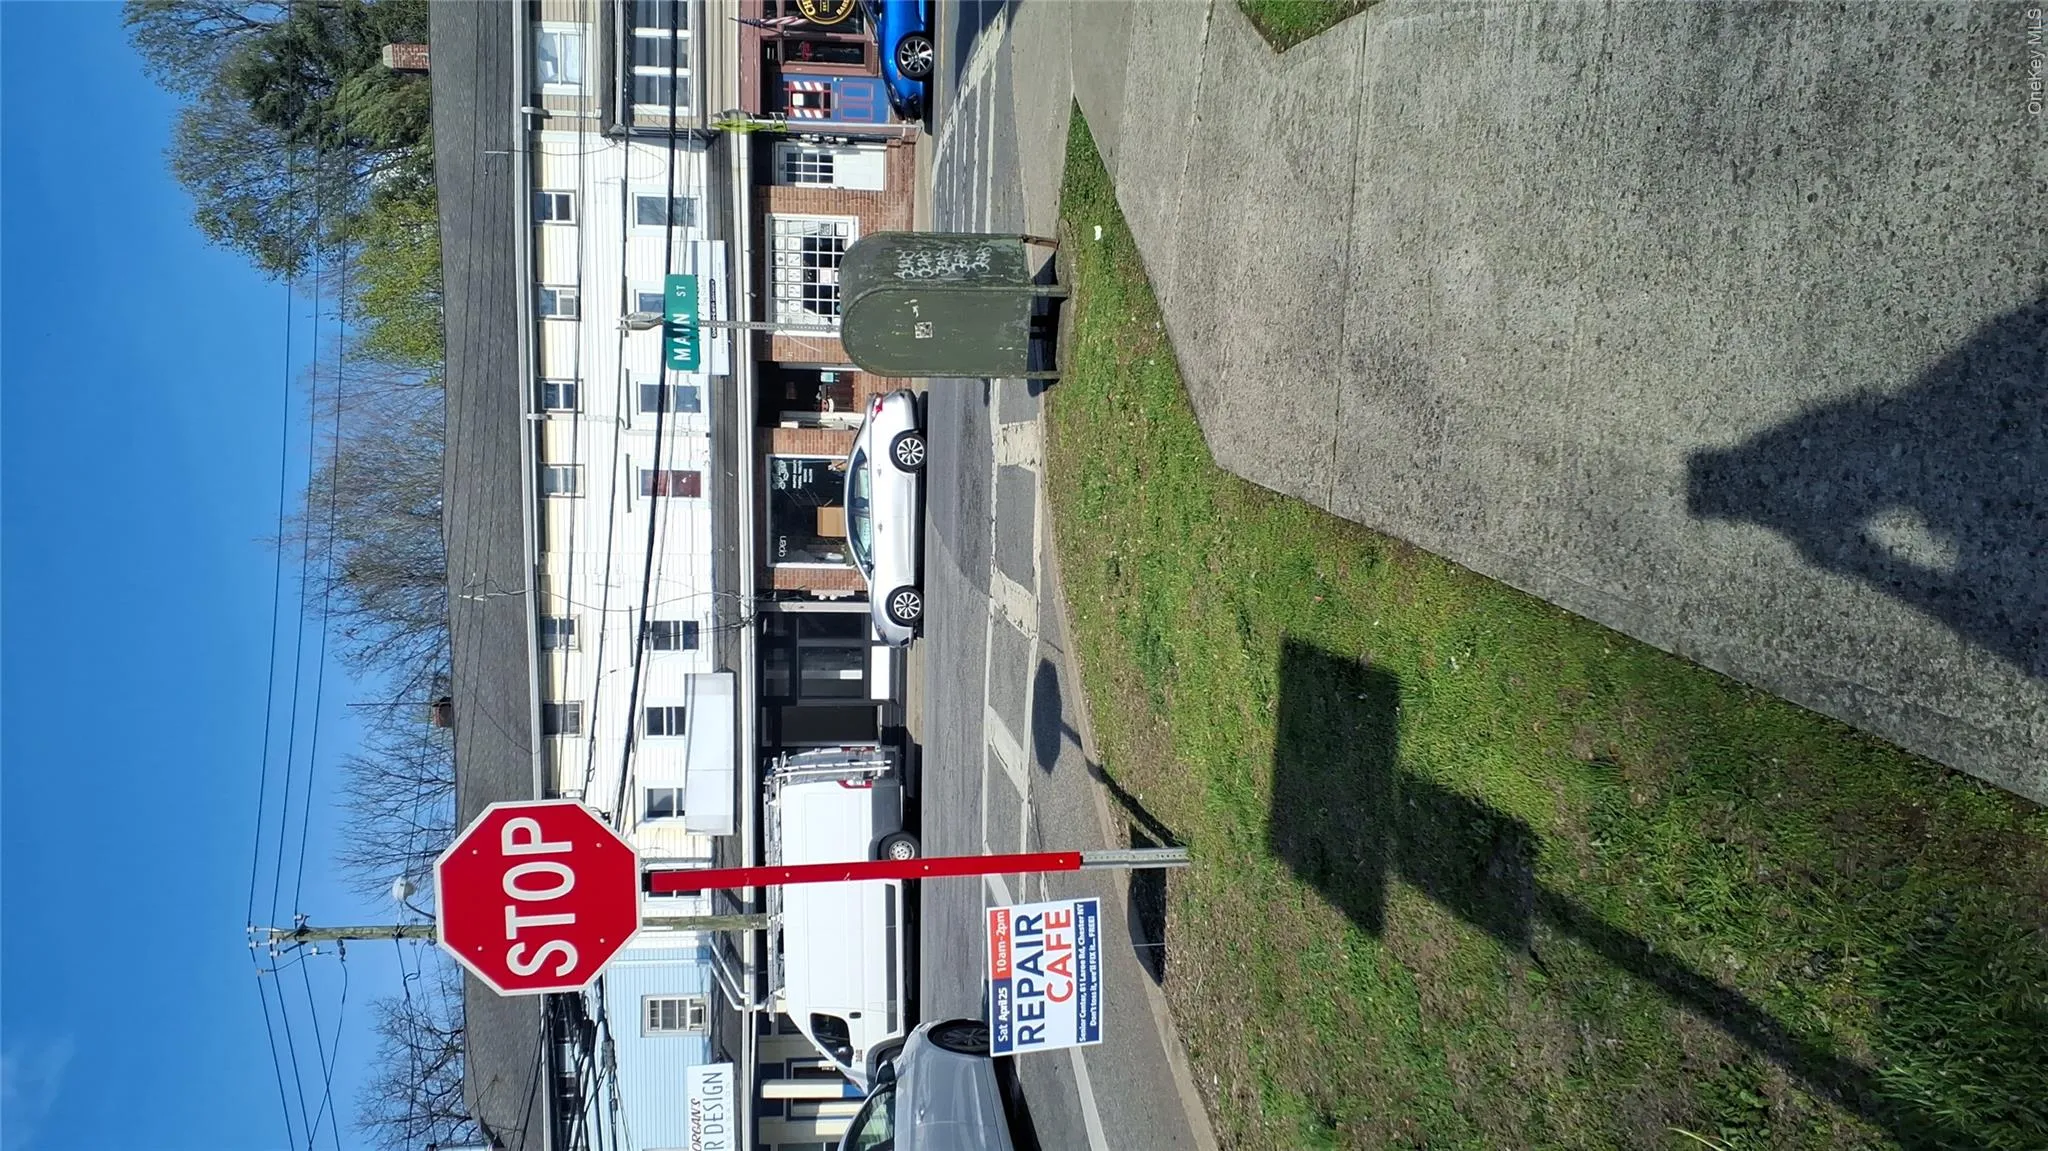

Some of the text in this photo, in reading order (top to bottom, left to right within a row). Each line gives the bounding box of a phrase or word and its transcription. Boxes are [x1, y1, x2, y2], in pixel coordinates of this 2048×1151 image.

[672, 284, 692, 360] MAIN ST
[778, 536, 787, 558] open
[500, 817, 579, 977] STOP
[1077, 904, 1084, 915] NY
[1078, 916, 1086, 945] Chester
[1088, 916, 1096, 937] FREE!
[1045, 909, 1073, 1003] CAFE
[1014, 912, 1045, 1046] REPAIR
[1079, 993, 1087, 1018] Center,
[998, 1024, 1008, 1042] Sat
[702, 1072, 724, 1134] DESIGN
